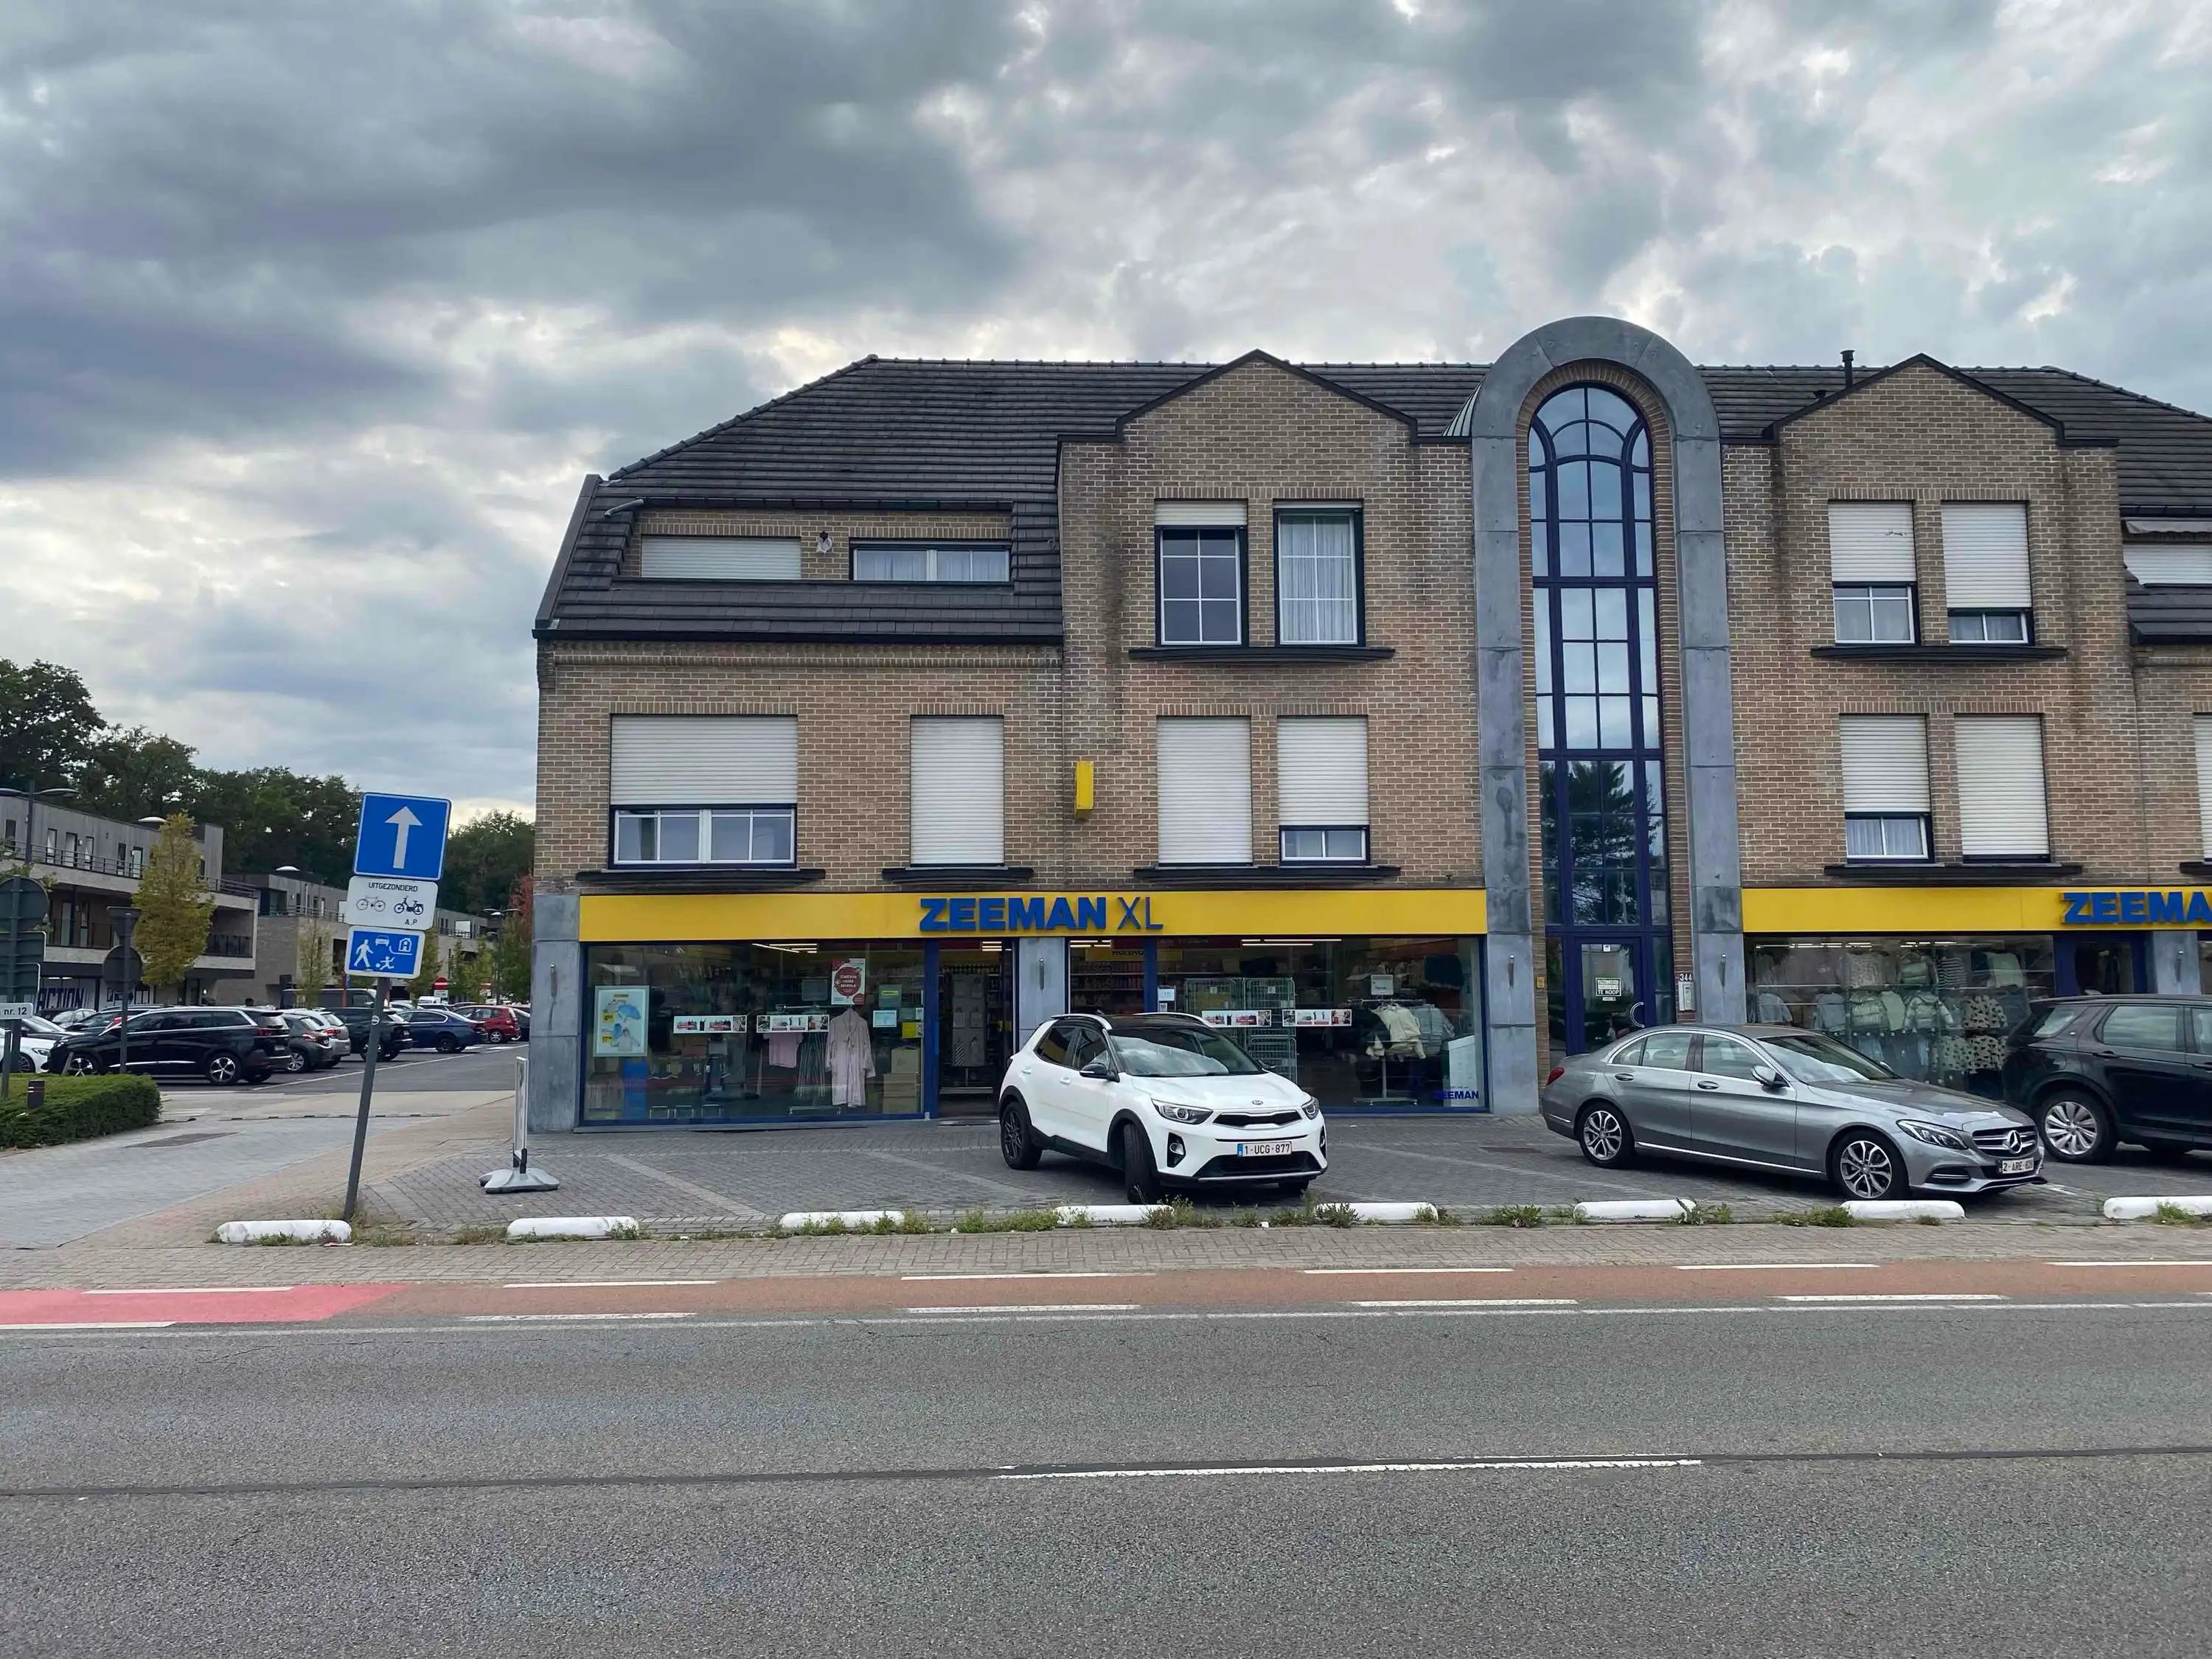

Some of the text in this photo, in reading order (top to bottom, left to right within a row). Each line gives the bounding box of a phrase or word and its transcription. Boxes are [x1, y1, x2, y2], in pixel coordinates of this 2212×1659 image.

[369, 882, 418, 892] UITGEZONDERD
[919, 897, 1164, 931] ZEEMAN XL
[1680, 973, 1692, 981] 344
[38, 988, 84, 1009] ACTION
[18, 1007, 27, 1015] 12
[1244, 1144, 1290, 1155] 1-UCG-877
